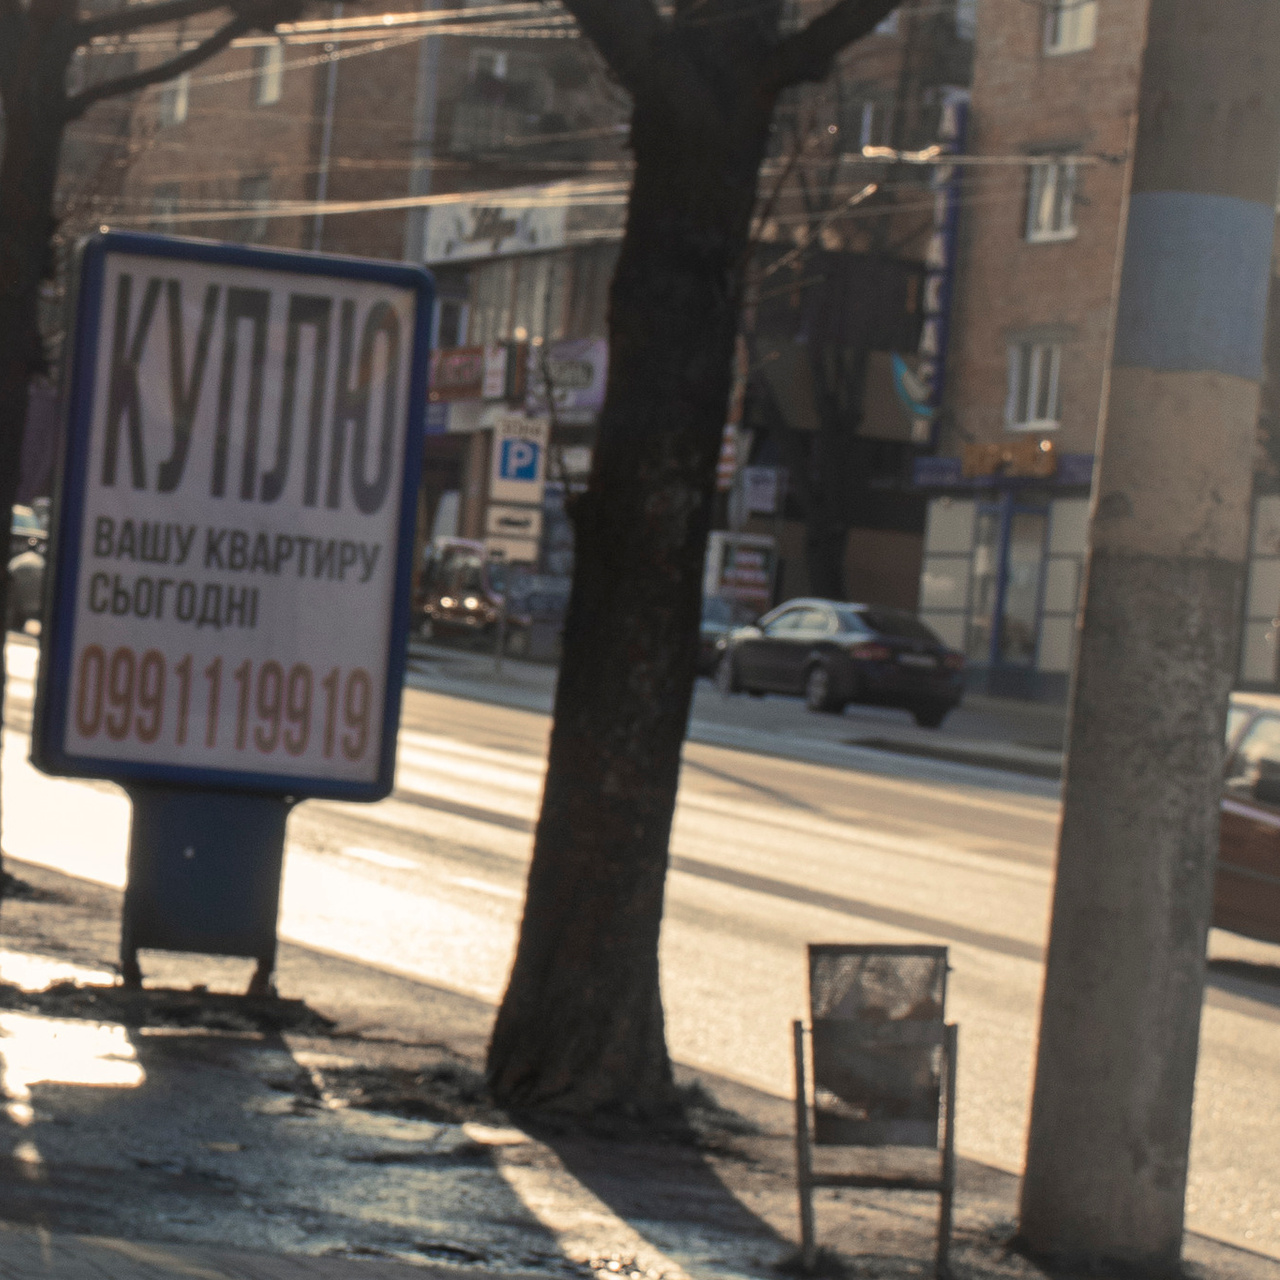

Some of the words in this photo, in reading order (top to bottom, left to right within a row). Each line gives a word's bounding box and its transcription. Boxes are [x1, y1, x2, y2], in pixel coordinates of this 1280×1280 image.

[101, 273, 402, 515] КУПЛЮ
[508, 442, 535, 478] P
[92, 517, 197, 567] ВАШУ
[204, 529, 382, 583] КВАРТИРУ
[88, 571, 260, 630] СЬОГОДНІ
[75, 644, 373, 762] 0991119919
